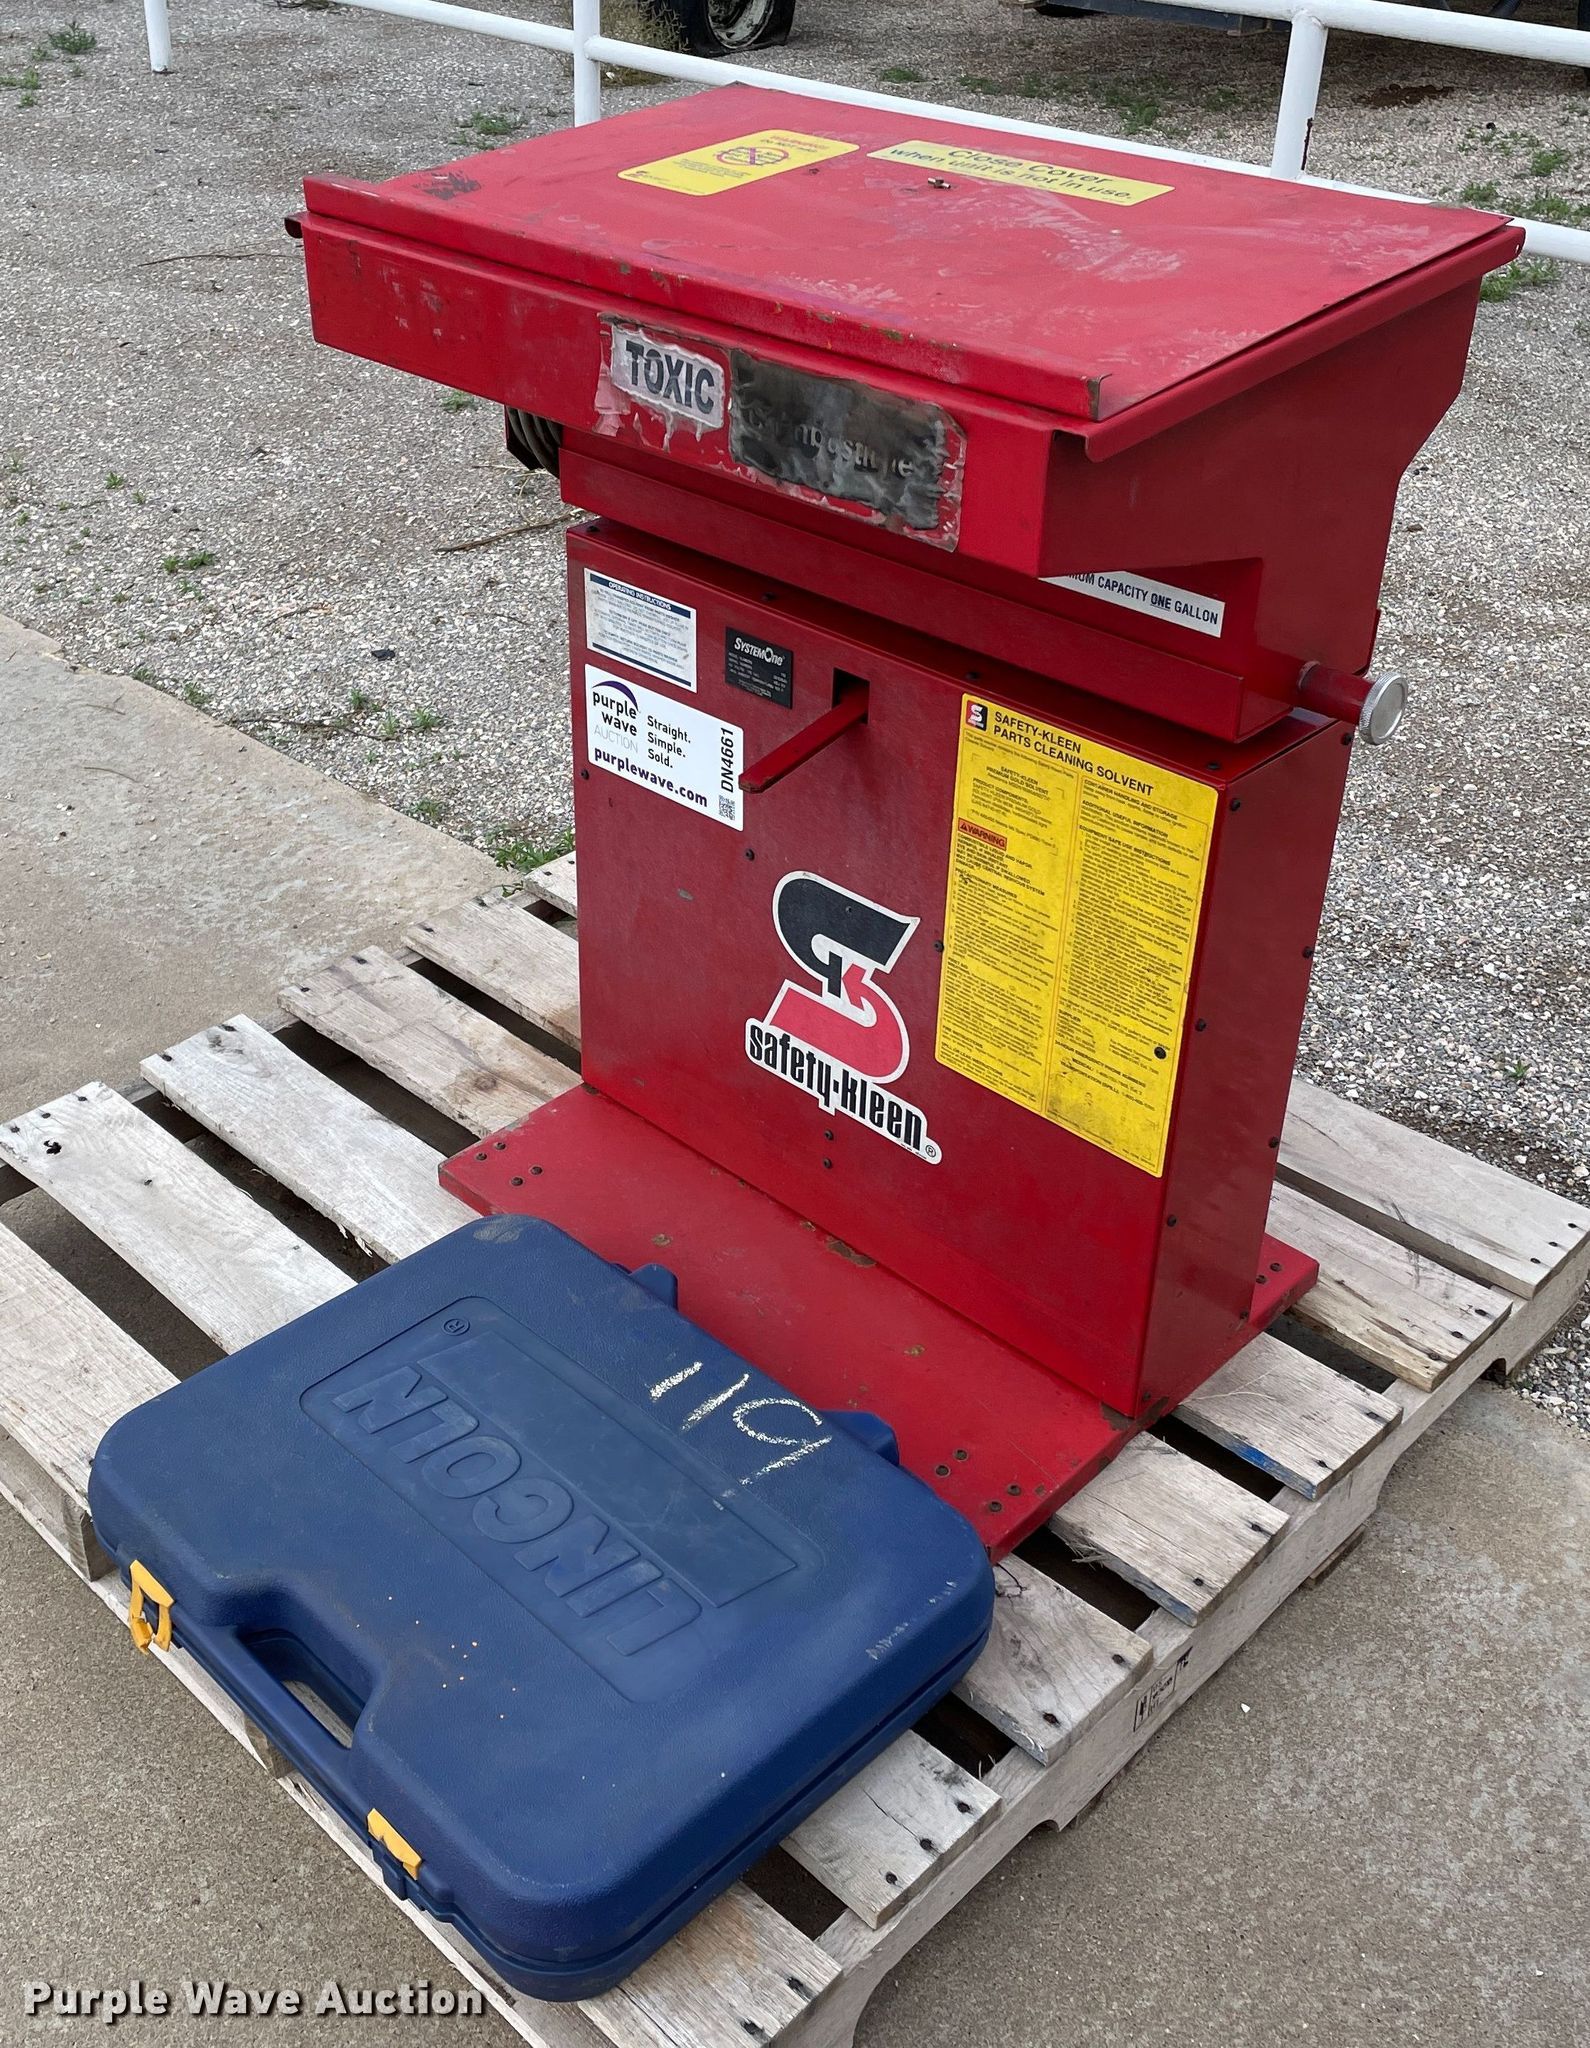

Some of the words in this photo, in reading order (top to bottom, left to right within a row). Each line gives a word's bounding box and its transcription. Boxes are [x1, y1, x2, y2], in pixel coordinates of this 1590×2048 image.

[890, 148, 945, 164] when
[948, 158, 989, 172] unit
[992, 166, 1015, 177] is
[1018, 170, 1057, 184] not
[1062, 178, 1083, 191] in
[1087, 184, 1132, 199] use.
[948, 150, 1023, 168] Close
[1028, 164, 1112, 184] Cover
[625, 339, 715, 415] TOXIC
[1097, 576, 1149, 602] CAPACITY
[1150, 592, 1172, 611] ONE
[1174, 600, 1218, 625] GALLON
[592, 691, 638, 719] purple
[601, 711, 638, 736] wave
[594, 724, 639, 753] AUCTION
[647, 715, 691, 743] Straight.
[647, 732, 686, 757] Simple.
[994, 710, 1081, 754] SAFETY-KLEEN
[594, 747, 708, 807] purplewave.com
[647, 748, 673, 768] Sold.
[720, 727, 734, 793] DN4661
[993, 724, 1030, 748] PARTS
[1033, 740, 1093, 773] CLEANING
[1096, 764, 1153, 797] SOLVENT
[966, 824, 1005, 847] WARNING
[648, 1361, 832, 1485] 119
[333, 1365, 702, 1657] LINCOLN
